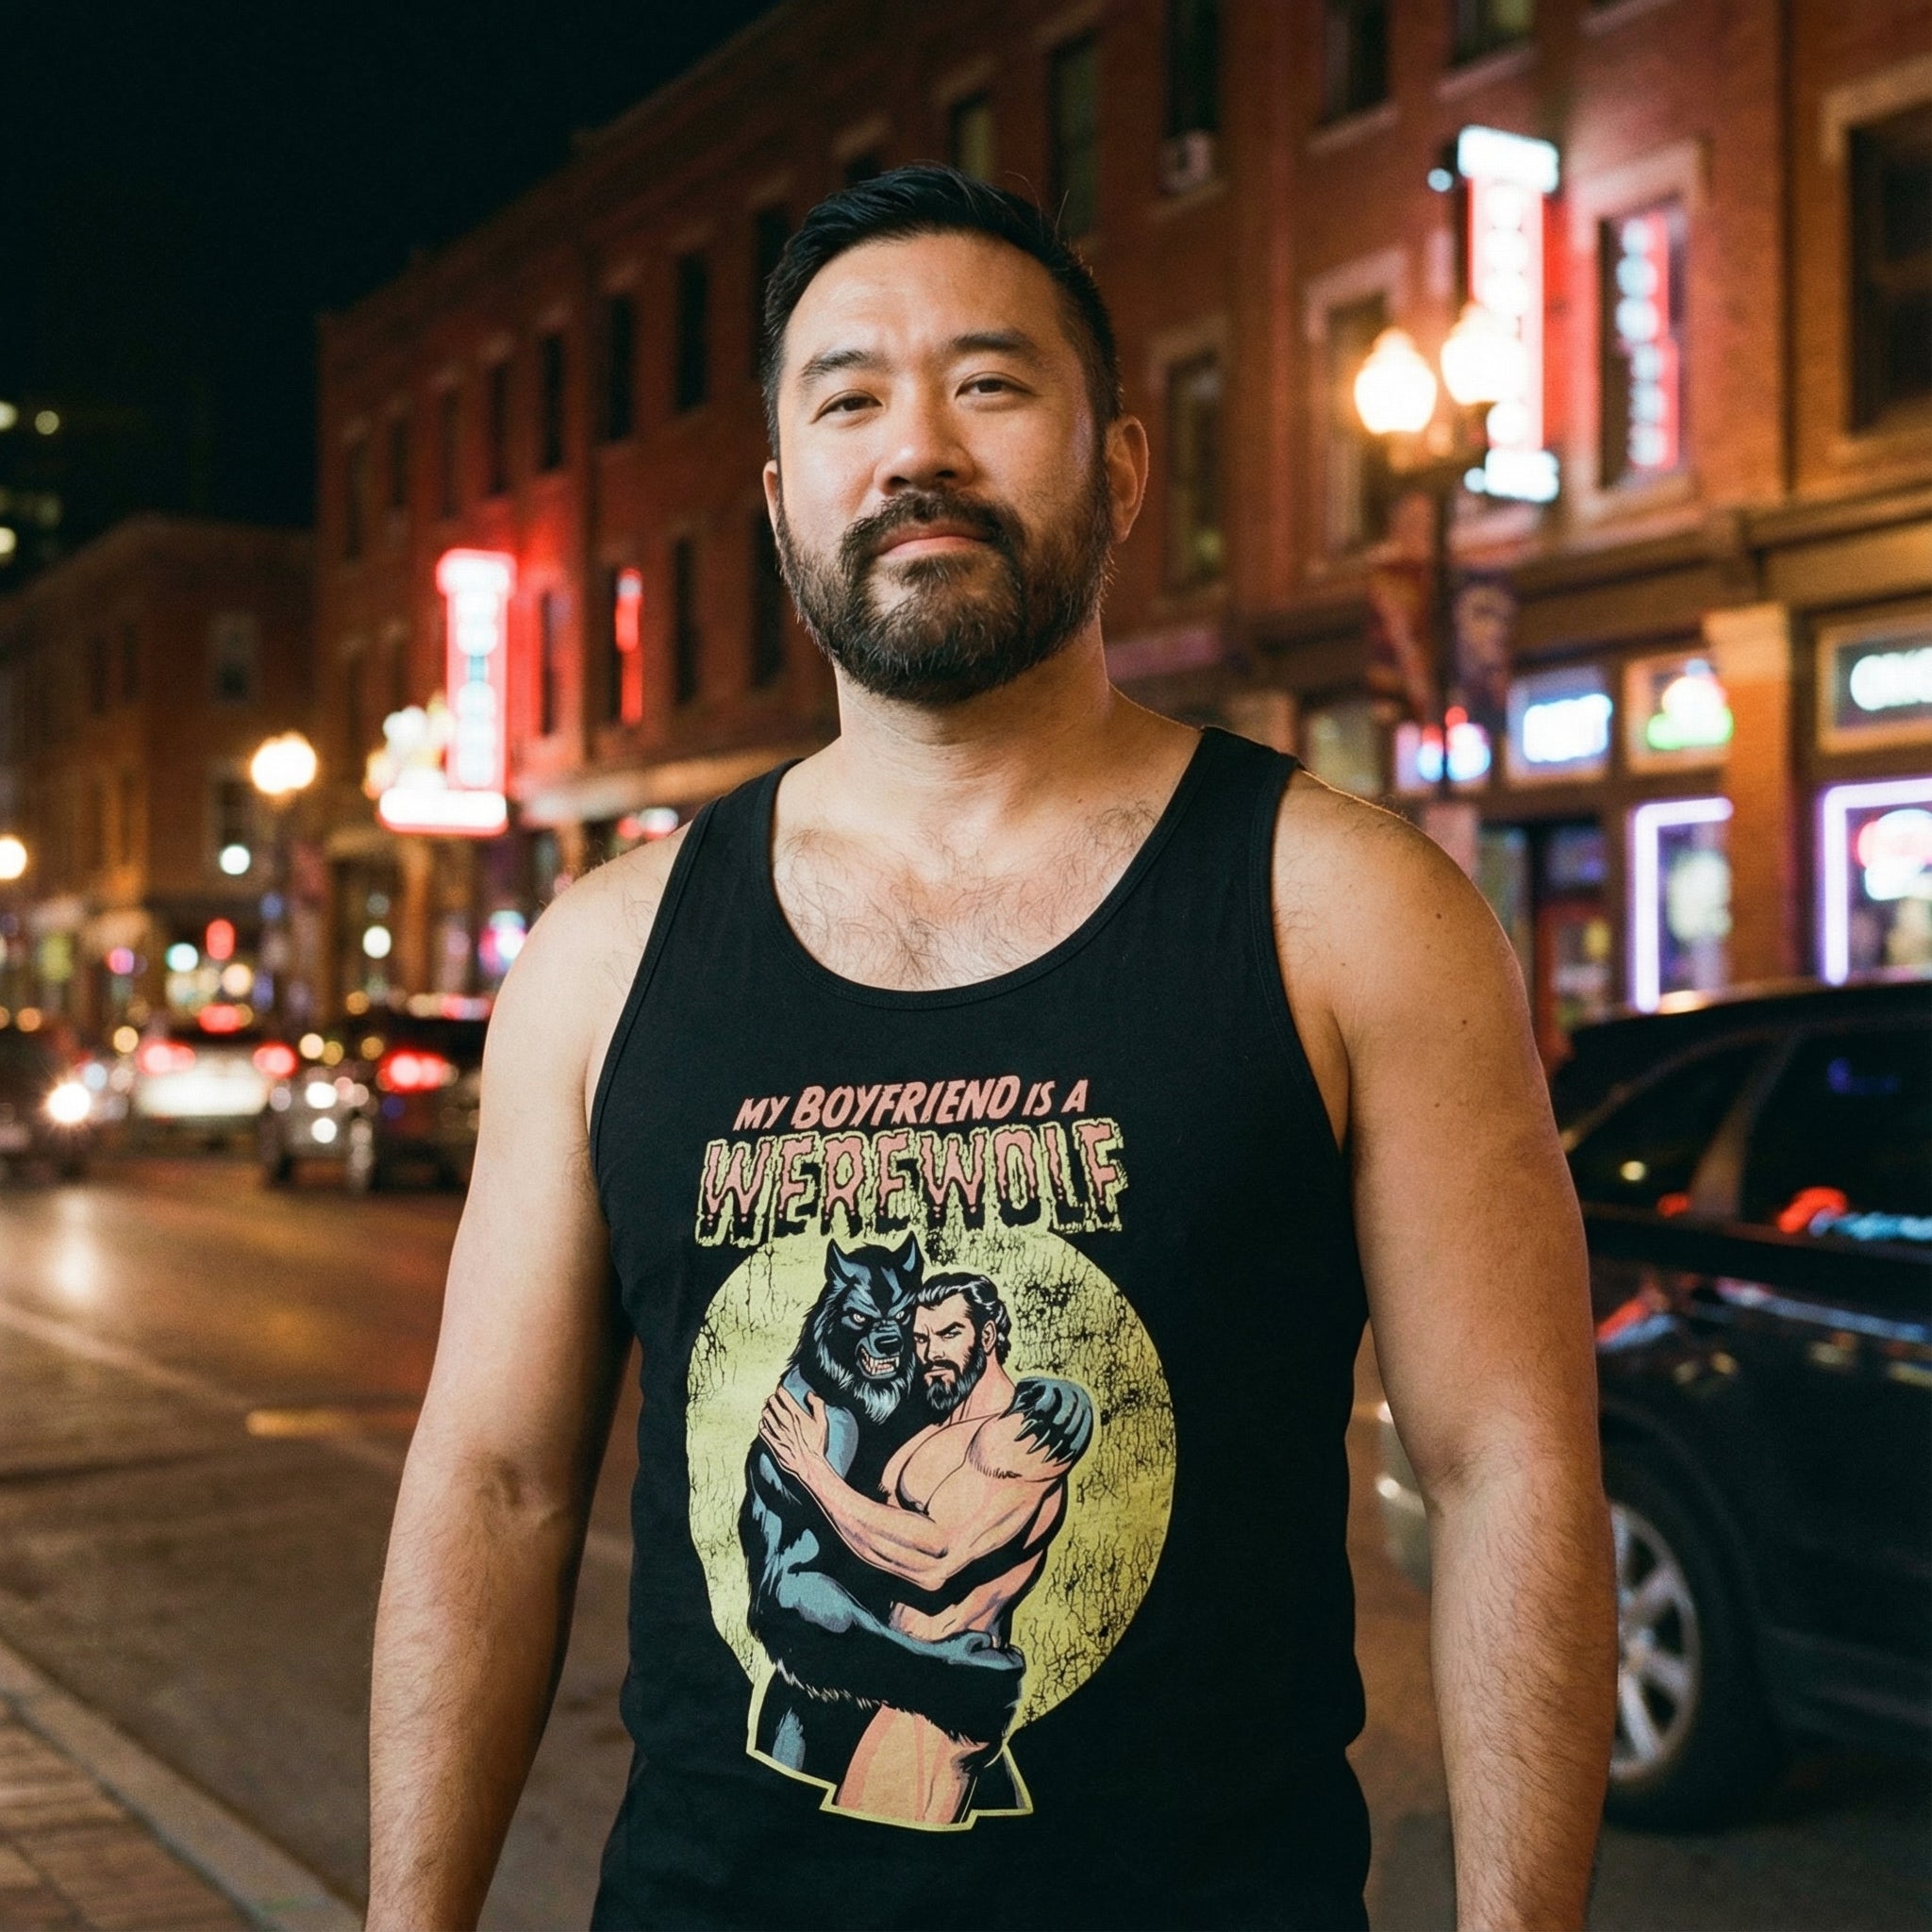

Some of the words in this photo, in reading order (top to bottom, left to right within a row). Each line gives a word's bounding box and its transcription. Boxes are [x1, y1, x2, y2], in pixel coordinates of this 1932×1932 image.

[733, 1095, 791, 1132] MY
[791, 1074, 1021, 1130] BOYFRIEND
[1023, 1079, 1056, 1117] IS
[1061, 1078, 1090, 1113] A
[694, 1118, 1129, 1246] WEREWOLF
